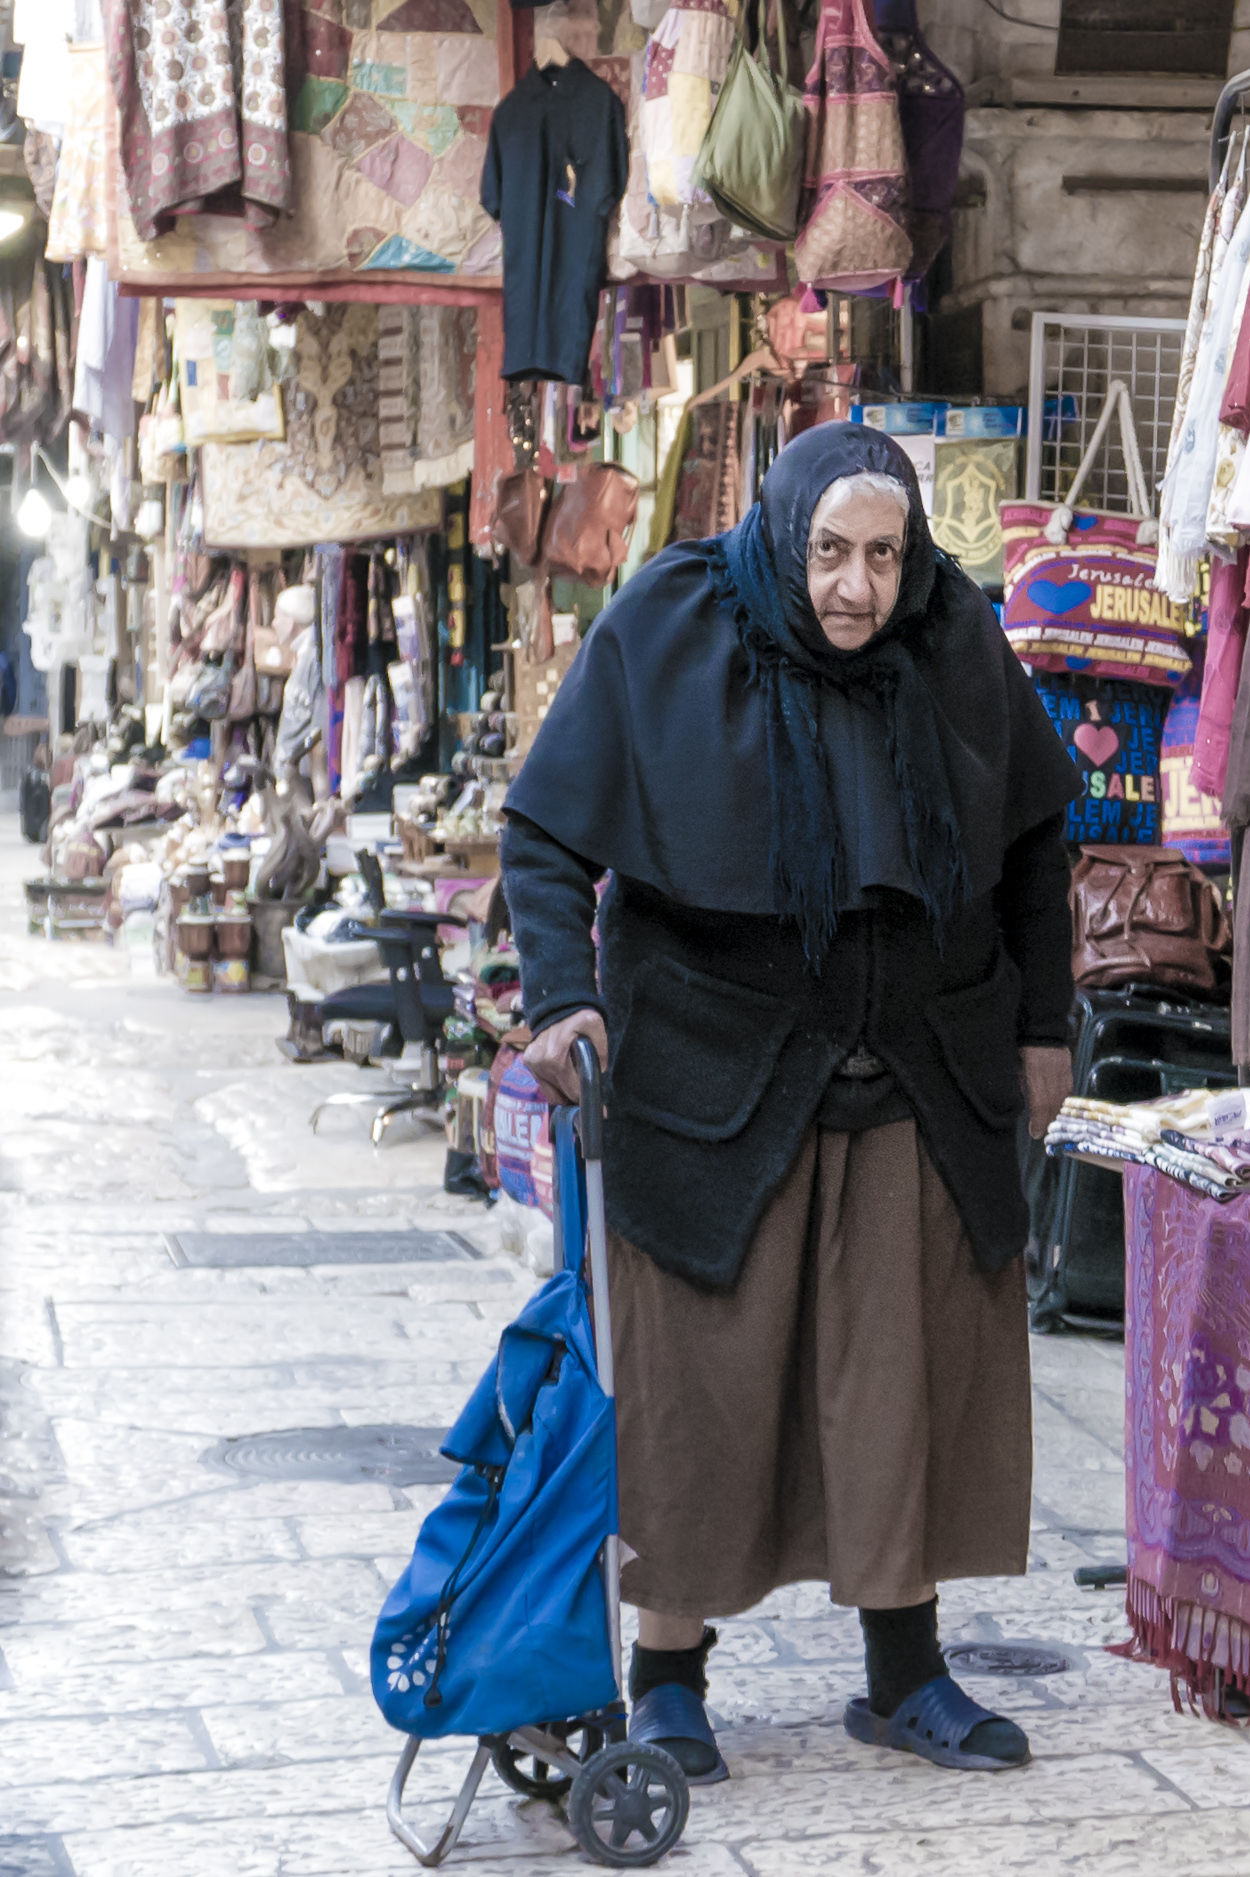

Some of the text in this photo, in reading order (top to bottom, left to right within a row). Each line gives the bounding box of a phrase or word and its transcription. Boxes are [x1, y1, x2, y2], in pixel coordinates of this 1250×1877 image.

[1068, 564, 1157, 588] Jerusale
[1090, 584, 1186, 632] JERUSALE
[1081, 770, 1160, 802] SALE
